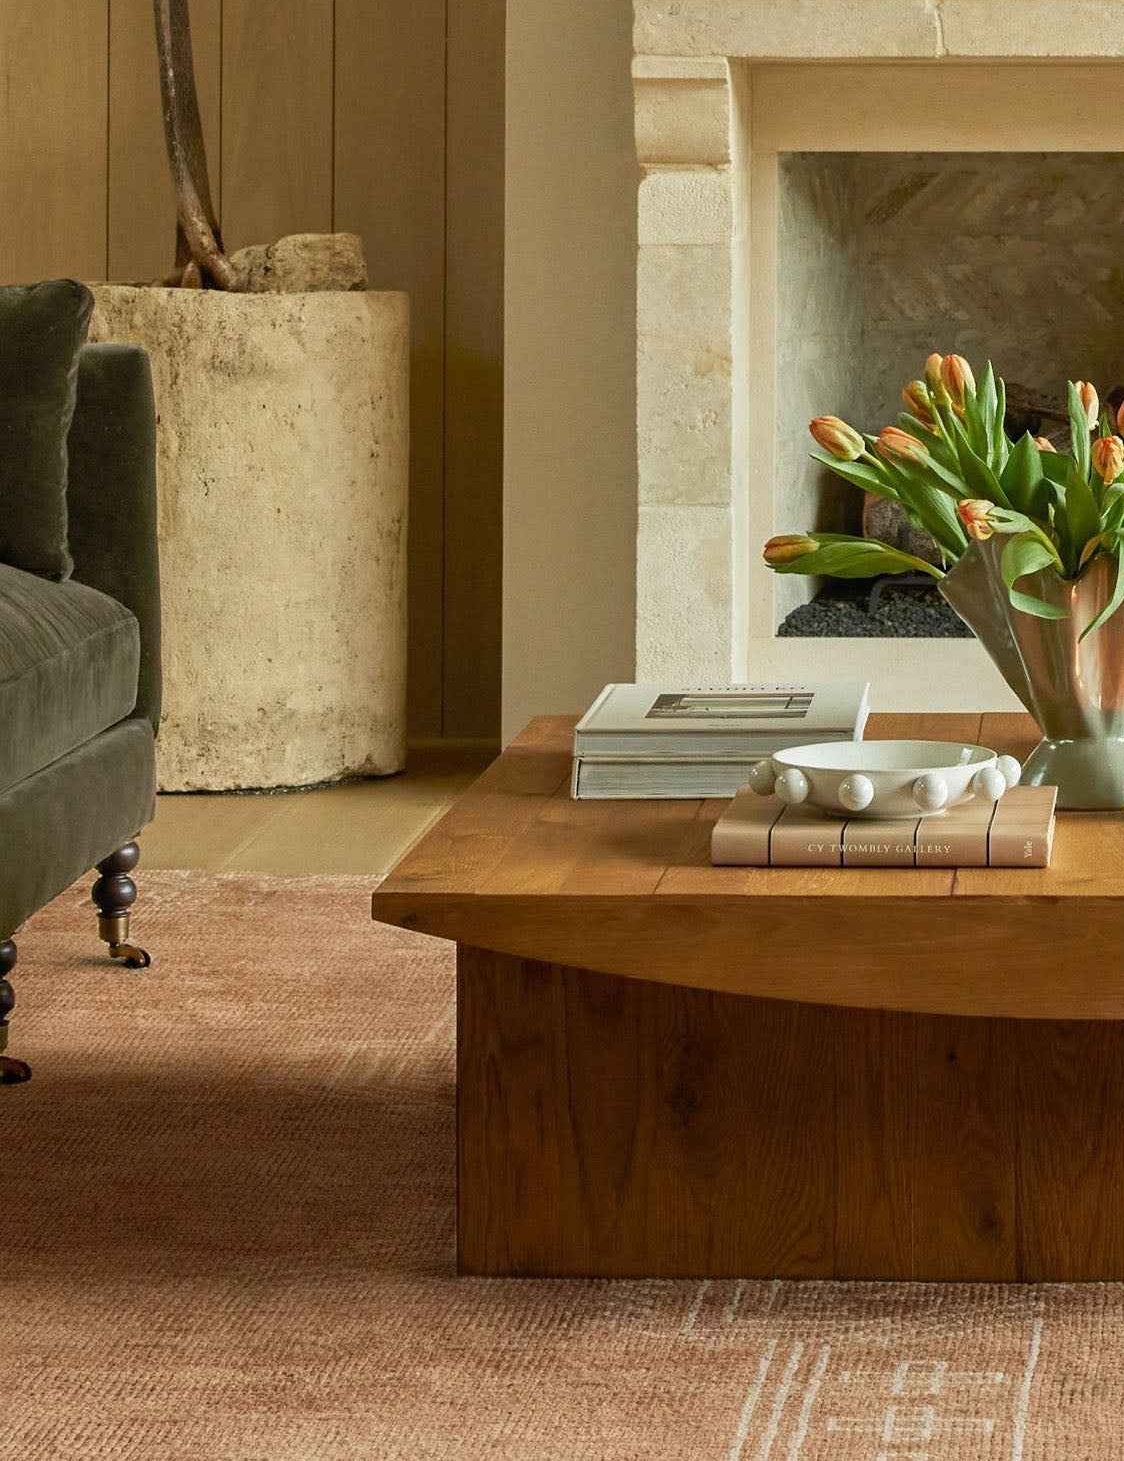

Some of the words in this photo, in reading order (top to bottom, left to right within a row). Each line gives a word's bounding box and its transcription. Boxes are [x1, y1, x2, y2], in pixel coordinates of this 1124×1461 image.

[807, 843, 824, 853] CY
[830, 843, 890, 853] TWOMBLY
[895, 844, 952, 854] GALLERY
[1023, 840, 1033, 858] Yale
